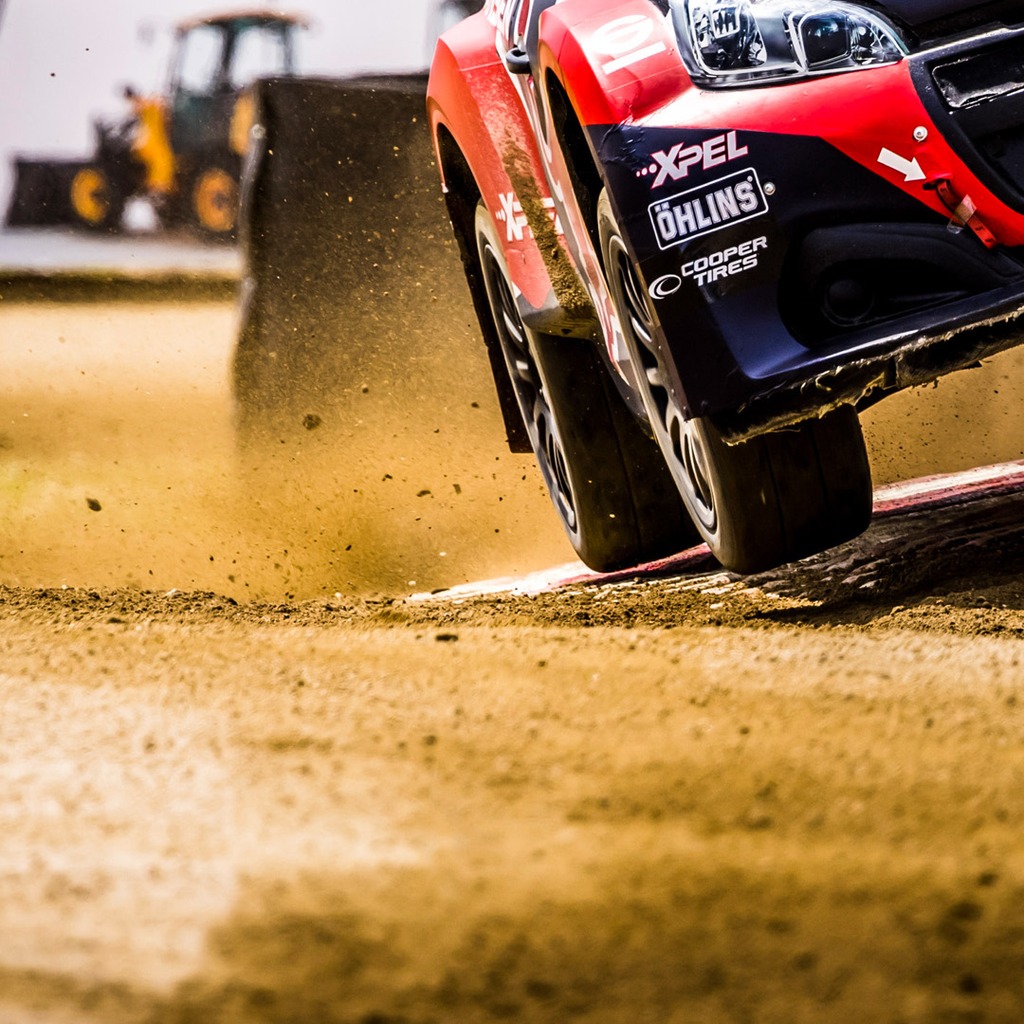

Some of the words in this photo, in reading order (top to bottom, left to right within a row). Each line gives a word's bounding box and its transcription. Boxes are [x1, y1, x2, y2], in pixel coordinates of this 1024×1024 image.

[650, 130, 749, 189] XPEL
[655, 176, 759, 242] ÖHLINS
[681, 235, 768, 277] COOPER
[693, 253, 758, 287] TIRES
